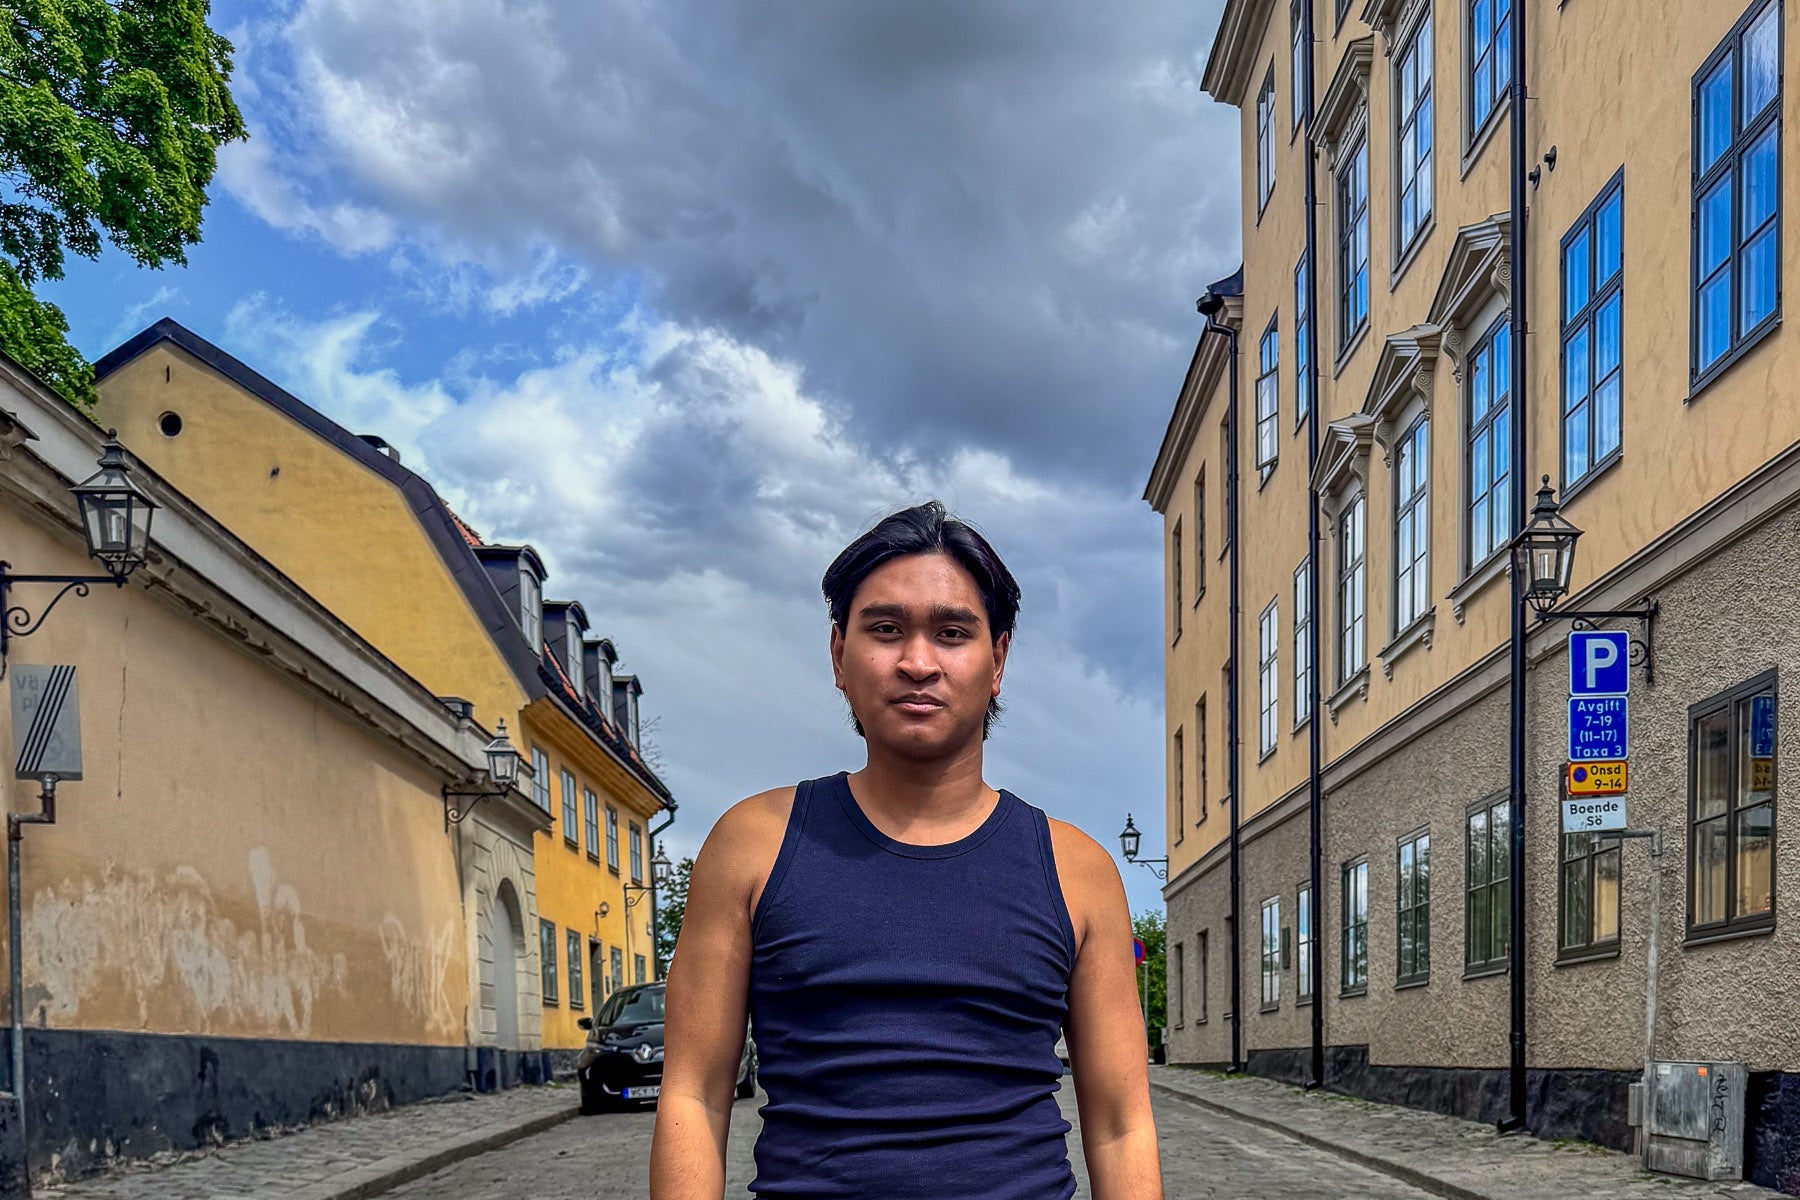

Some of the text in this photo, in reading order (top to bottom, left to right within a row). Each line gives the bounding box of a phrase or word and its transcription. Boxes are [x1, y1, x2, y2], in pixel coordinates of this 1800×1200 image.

[1586, 638, 1618, 688] P
[1577, 700, 1620, 714] Avgift
[1584, 715, 1612, 727] 7-19
[1580, 729, 1617, 743] (11-17)
[1575, 745, 1622, 757] Taxa 3
[1590, 764, 1621, 776] Onsd
[1594, 778, 1622, 790] 9-14
[1570, 801, 1618, 815] Boende
[1586, 815, 1602, 826] Sö
